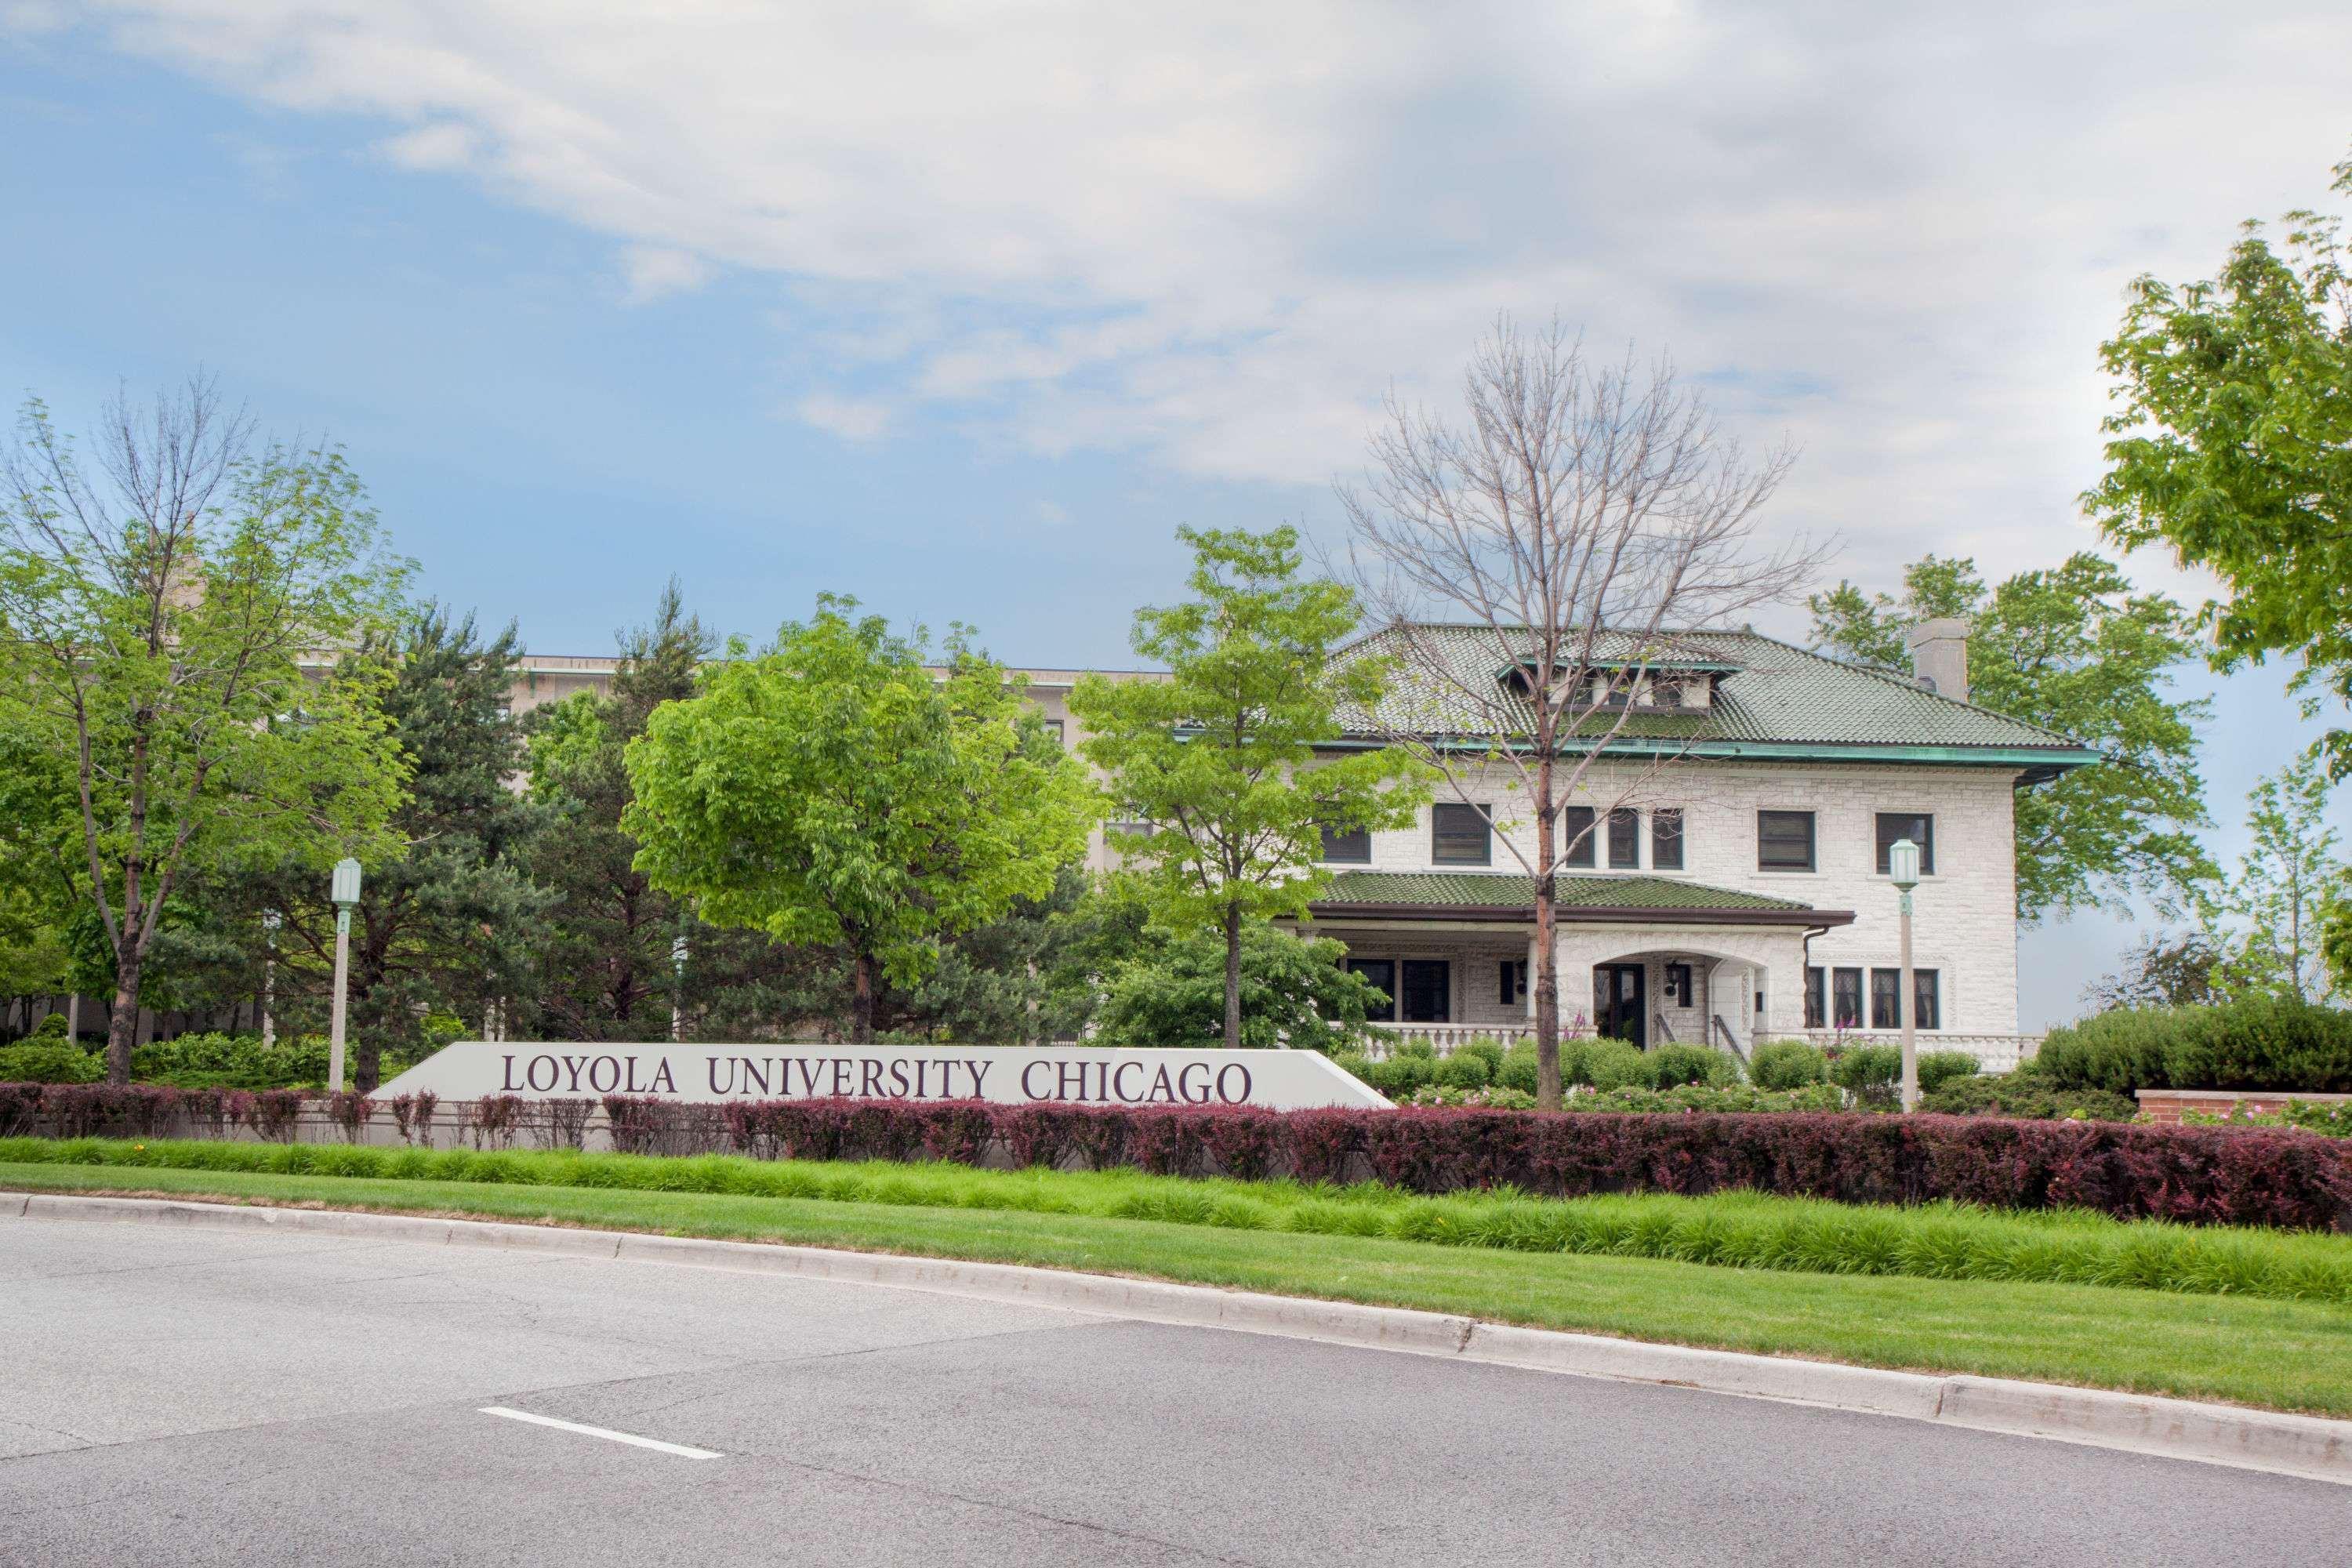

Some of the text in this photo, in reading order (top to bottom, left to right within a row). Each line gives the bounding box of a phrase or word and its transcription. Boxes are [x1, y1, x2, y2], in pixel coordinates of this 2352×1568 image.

[499, 1054, 1253, 1105] LOYOLA UNIVERSITY CHICAGO
